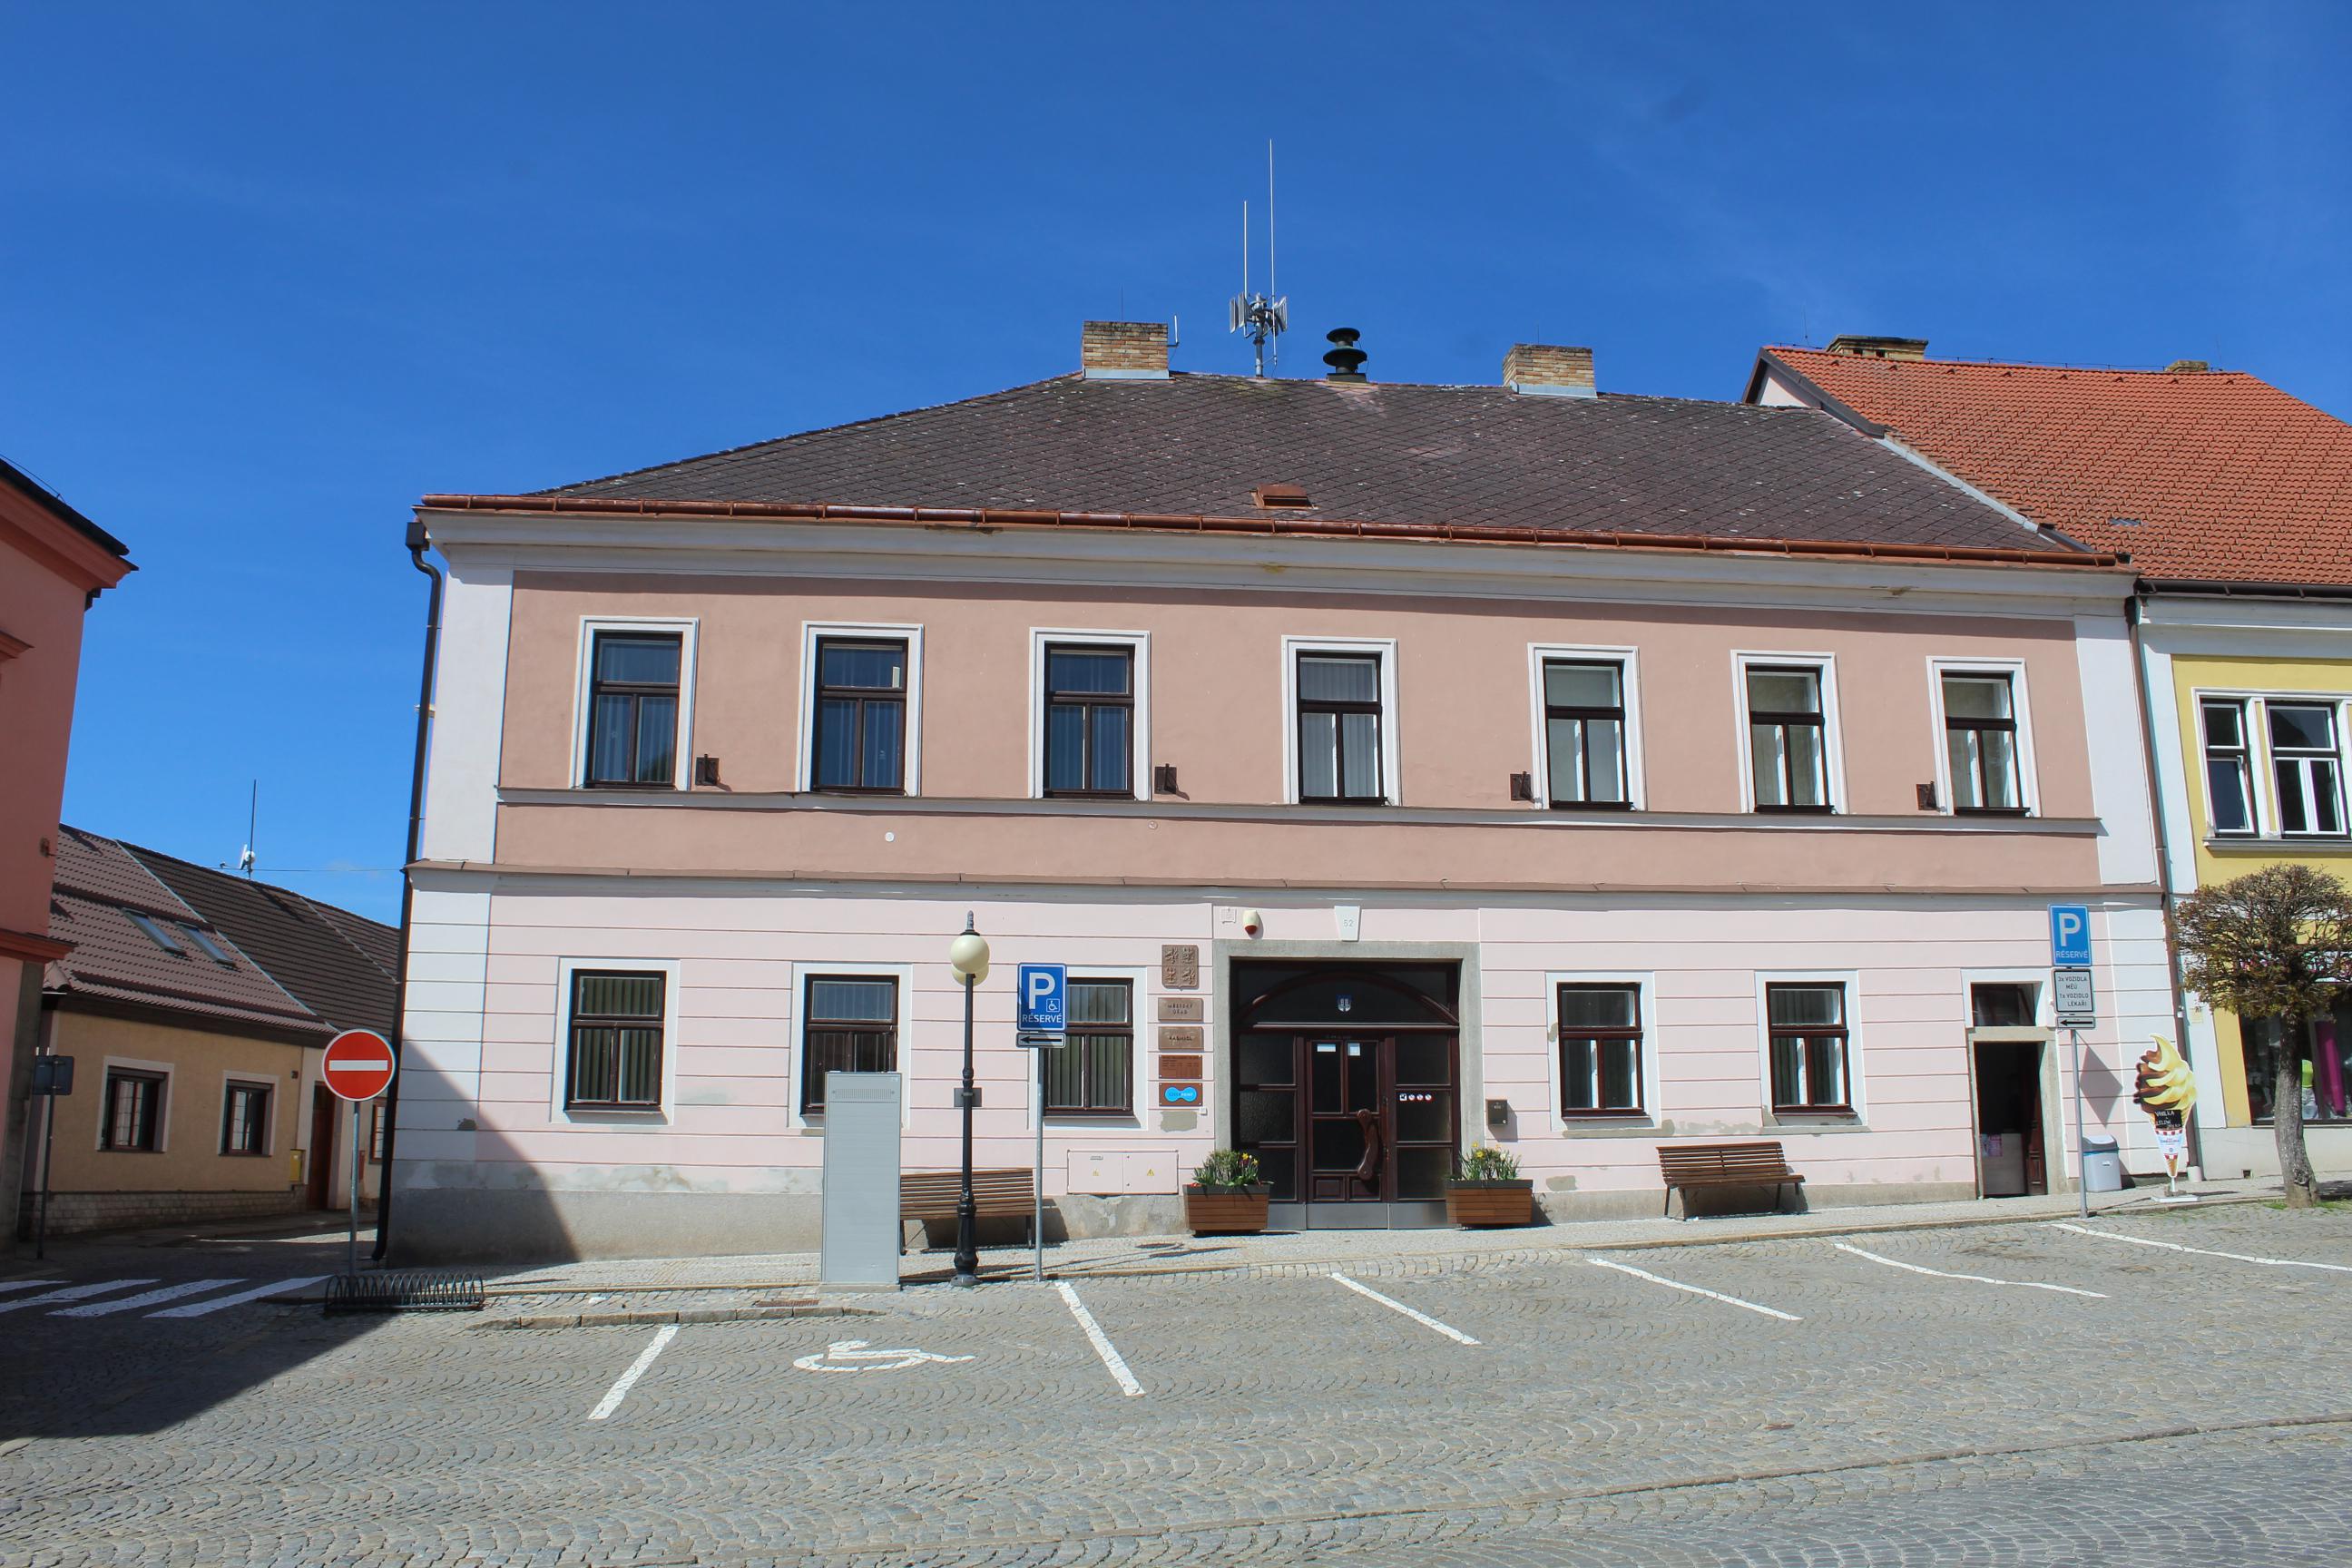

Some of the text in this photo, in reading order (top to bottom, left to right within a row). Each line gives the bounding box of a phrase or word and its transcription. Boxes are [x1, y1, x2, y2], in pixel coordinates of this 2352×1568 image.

[2059, 913, 2081, 946] P
[2055, 950, 2089, 959] RÉSERVÉ
[1029, 972, 1055, 1009] P
[1022, 1013, 1063, 1023] RÉSERVÉ
